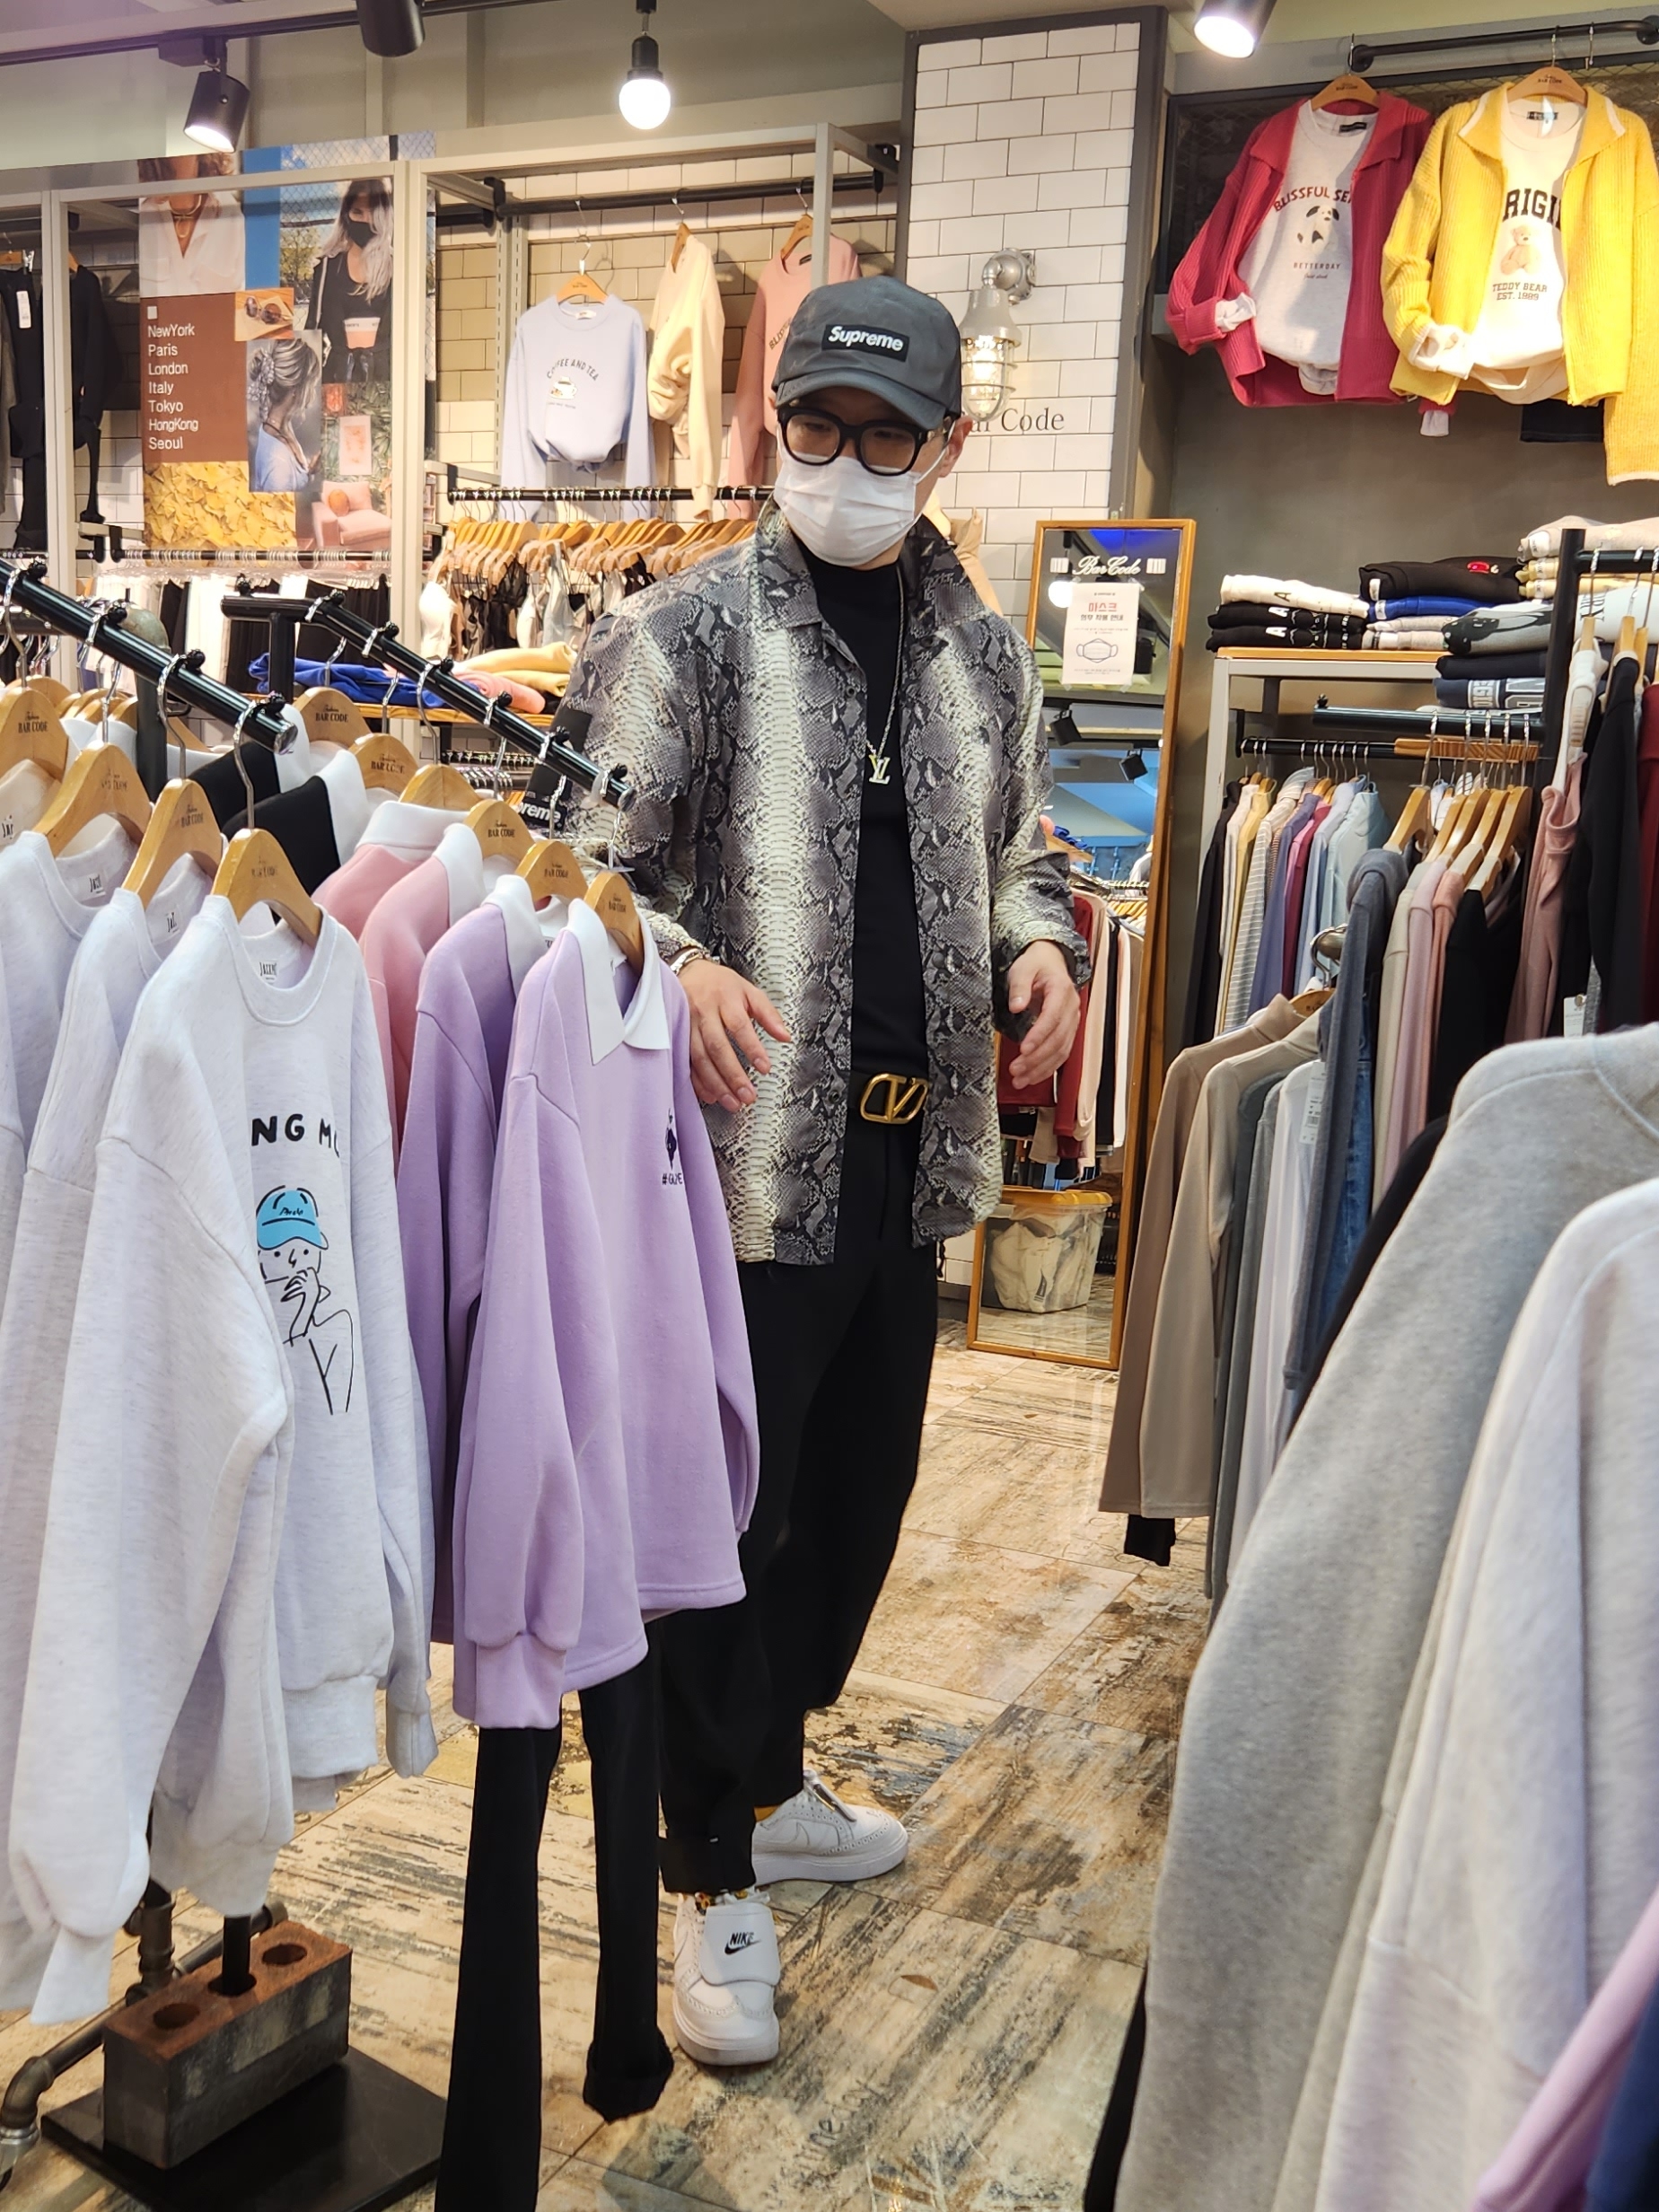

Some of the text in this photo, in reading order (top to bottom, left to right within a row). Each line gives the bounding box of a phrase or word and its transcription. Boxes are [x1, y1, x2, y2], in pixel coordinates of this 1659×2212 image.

[1274, 187, 1351, 212] BLISSFUL SE
[1502, 188, 1562, 233] RIGI
[1492, 282, 1548, 293] TEDDY BEAR
[1497, 292, 1515, 301] EST.
[147, 323, 195, 338] NewYork
[828, 326, 904, 351] Supreme
[148, 343, 178, 356] Paris
[148, 362, 189, 375] London
[570, 359, 586, 371] AND
[586, 365, 599, 381] TEA
[148, 381, 174, 395] Italy
[148, 399, 183, 414] Tokyo
[148, 417, 198, 433] HongKong
[1001, 407, 1065, 432] Code
[148, 436, 183, 450] Seoul
[1088, 602, 1118, 612] 마스크
[315, 713, 348, 723] BAR CODE
[251, 1113, 305, 1146] NG
[729, 1931, 755, 1946] NIKE
